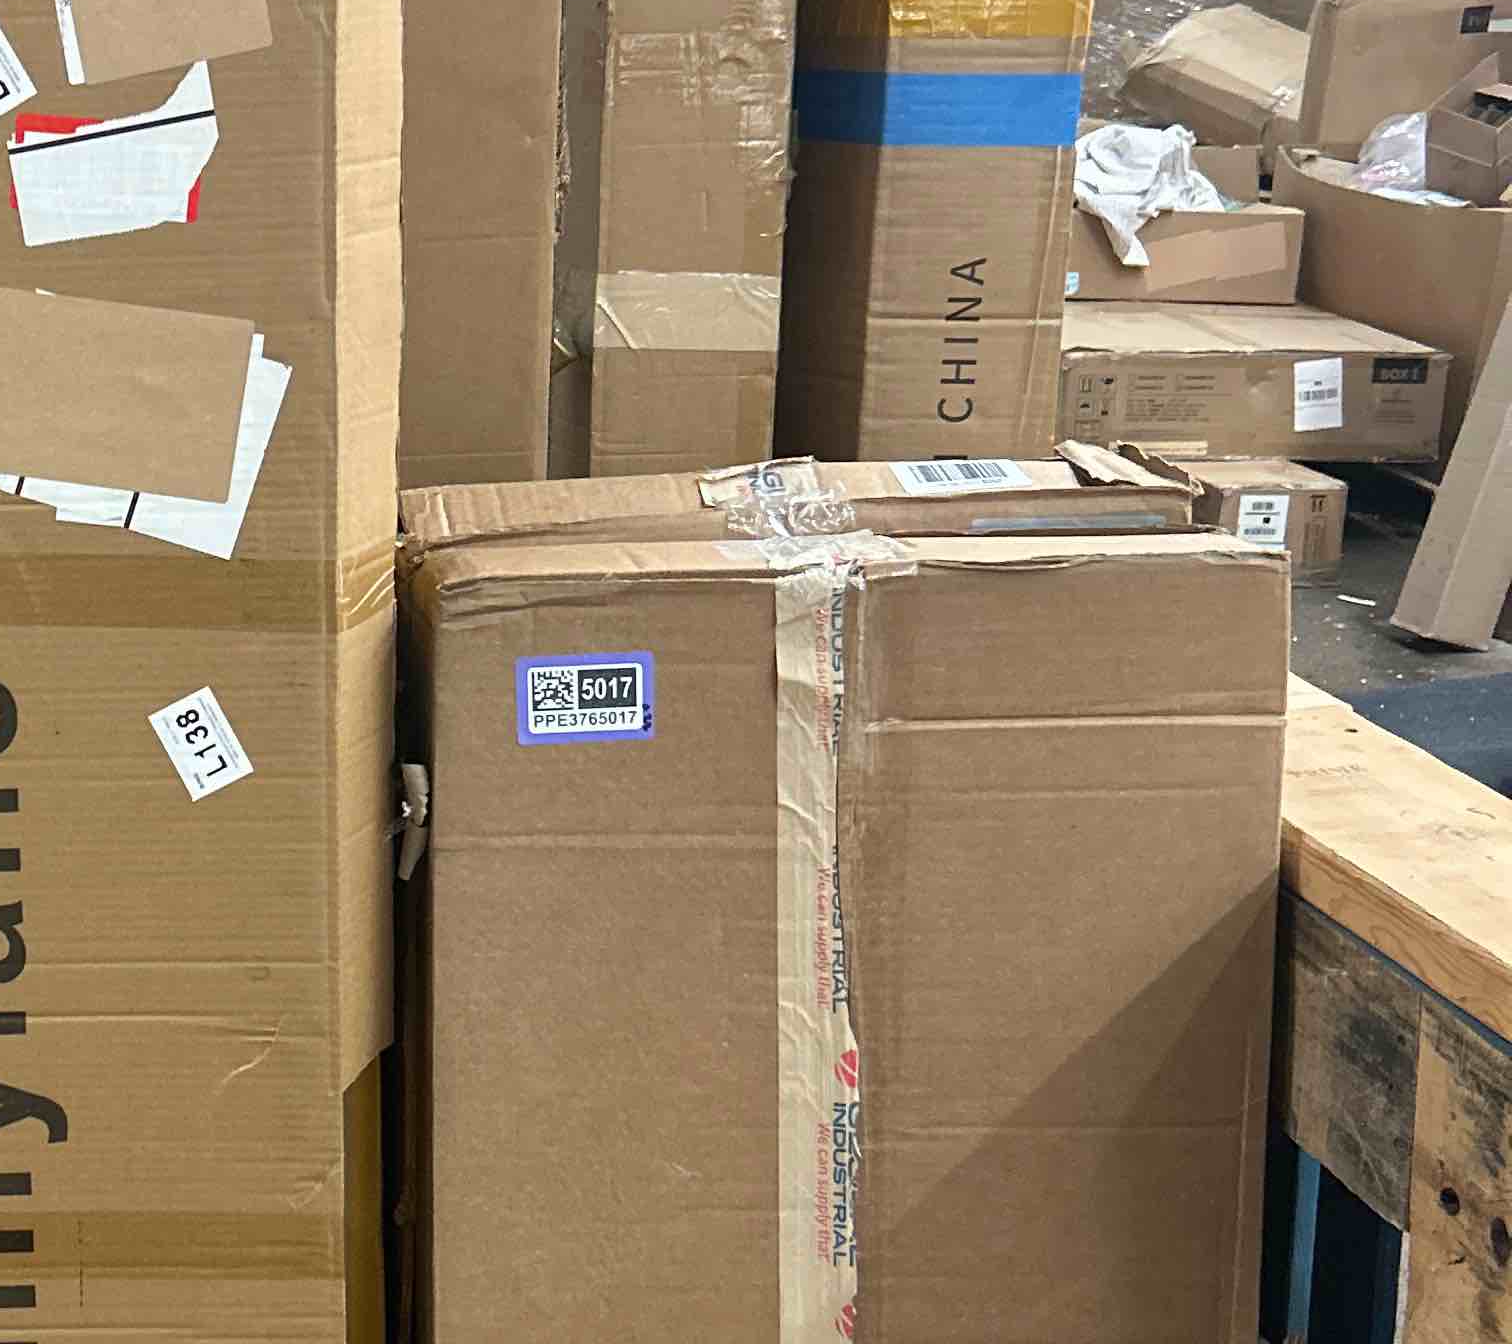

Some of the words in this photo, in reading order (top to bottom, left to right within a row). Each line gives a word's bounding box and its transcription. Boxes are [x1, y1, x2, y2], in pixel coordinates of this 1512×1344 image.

[937, 258, 987, 422] CHINA
[534, 711, 637, 728] PPE3765017
[581, 677, 632, 700] 5017
[176, 709, 228, 777] L138
[833, 1102, 847, 1267] INDUSTRIAL
